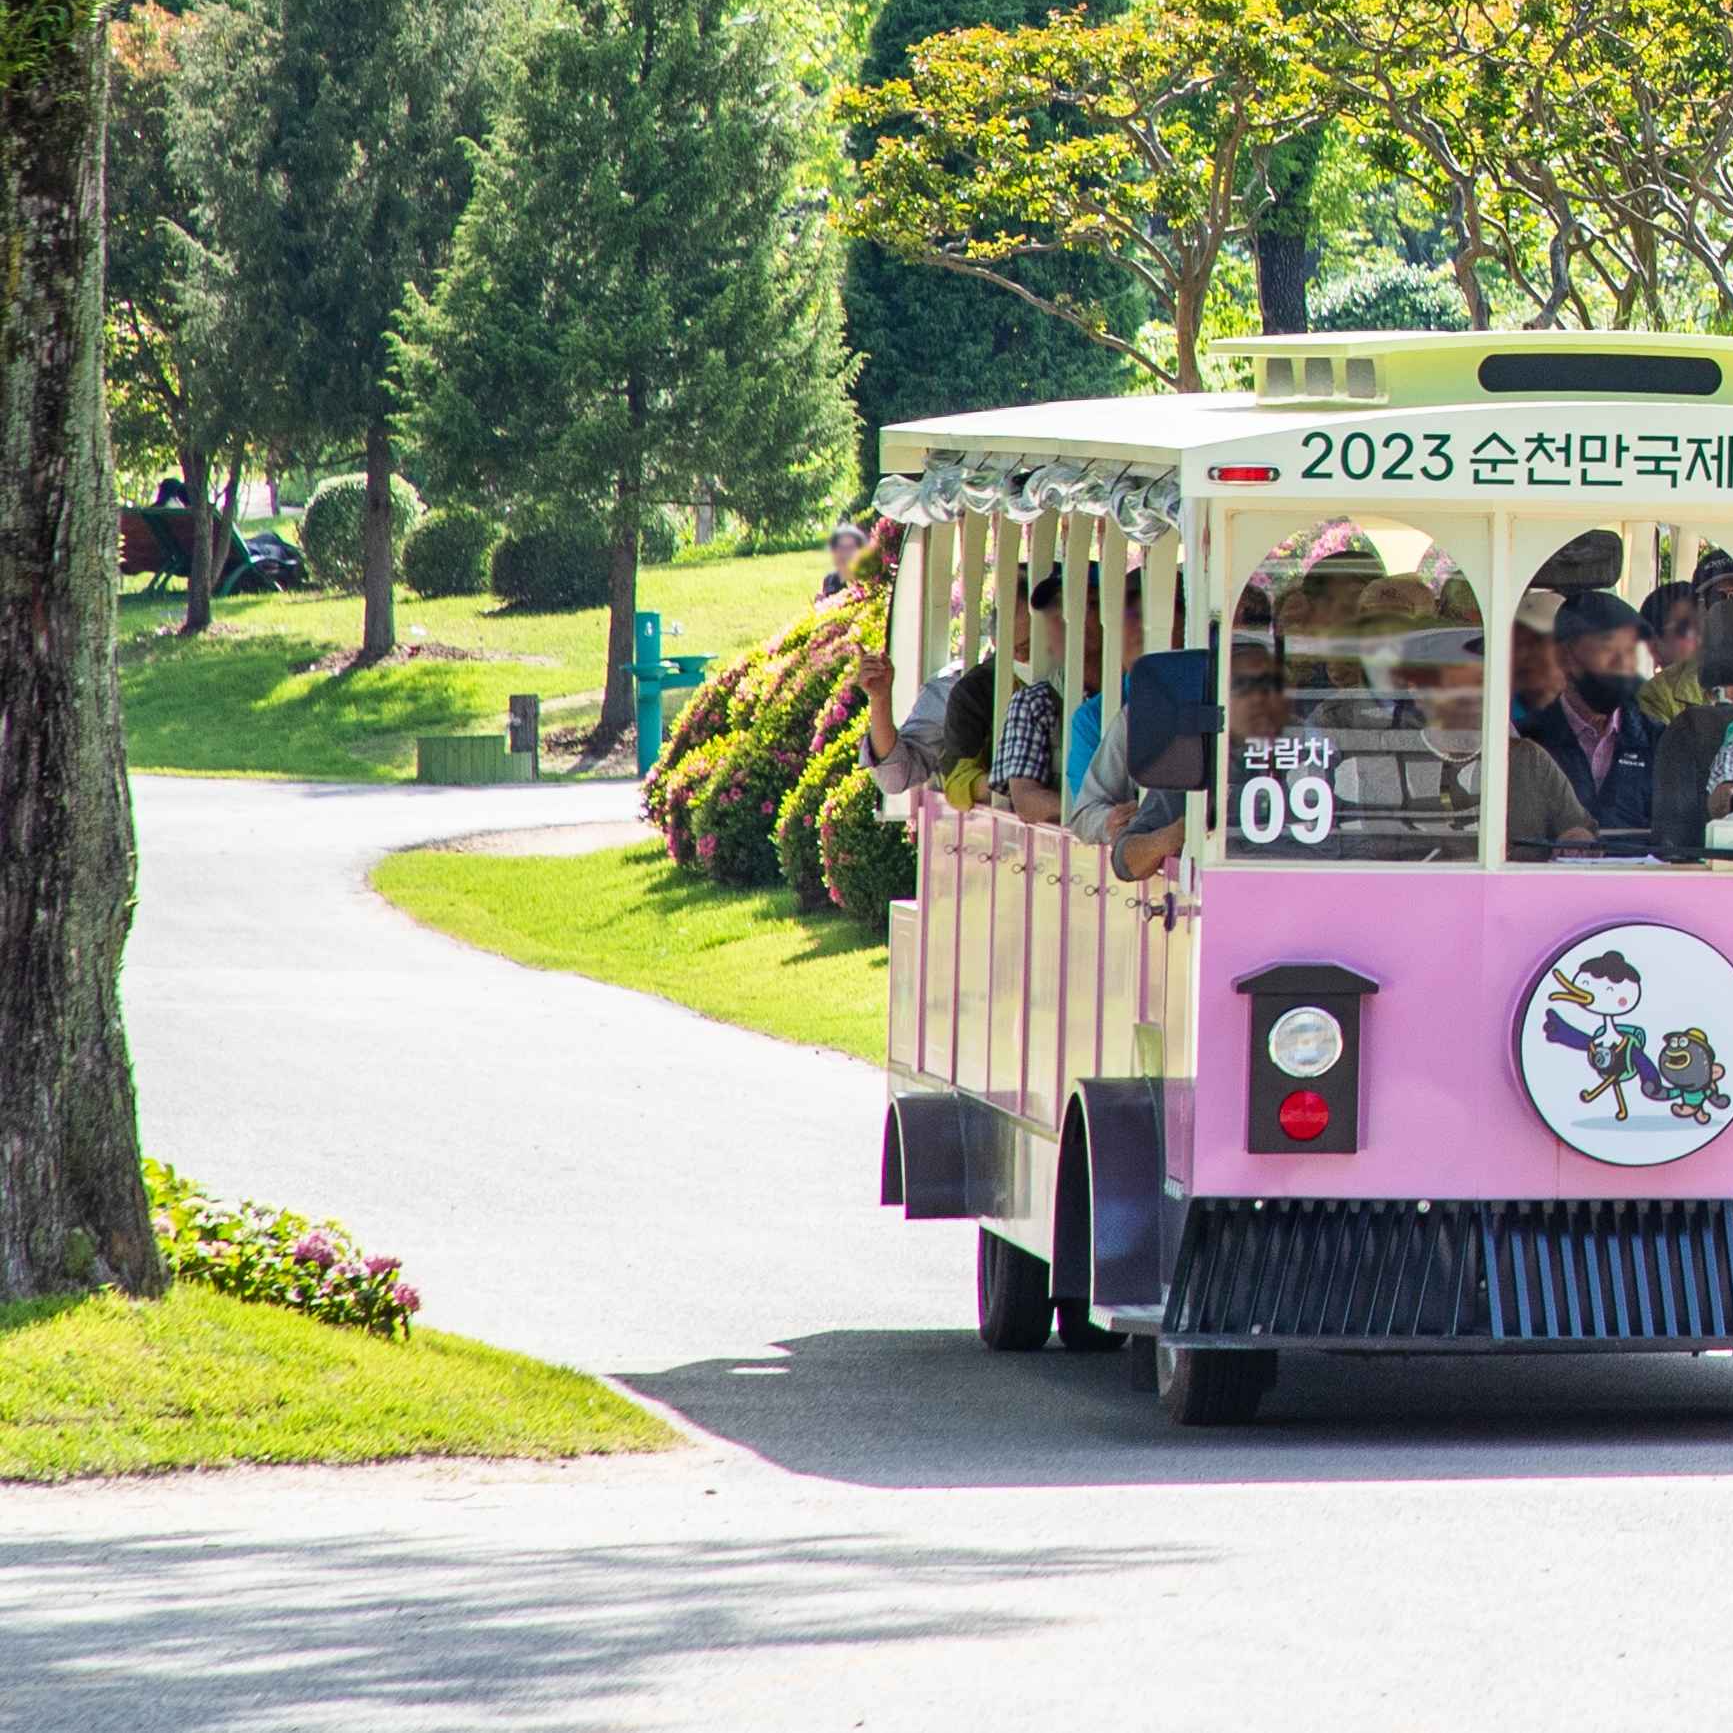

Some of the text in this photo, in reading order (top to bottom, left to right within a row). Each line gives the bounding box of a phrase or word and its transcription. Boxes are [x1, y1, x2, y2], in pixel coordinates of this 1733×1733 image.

[1301, 431, 1454, 482] 2023
[1243, 737, 1334, 770] 관람차
[1240, 776, 1333, 844] 09
